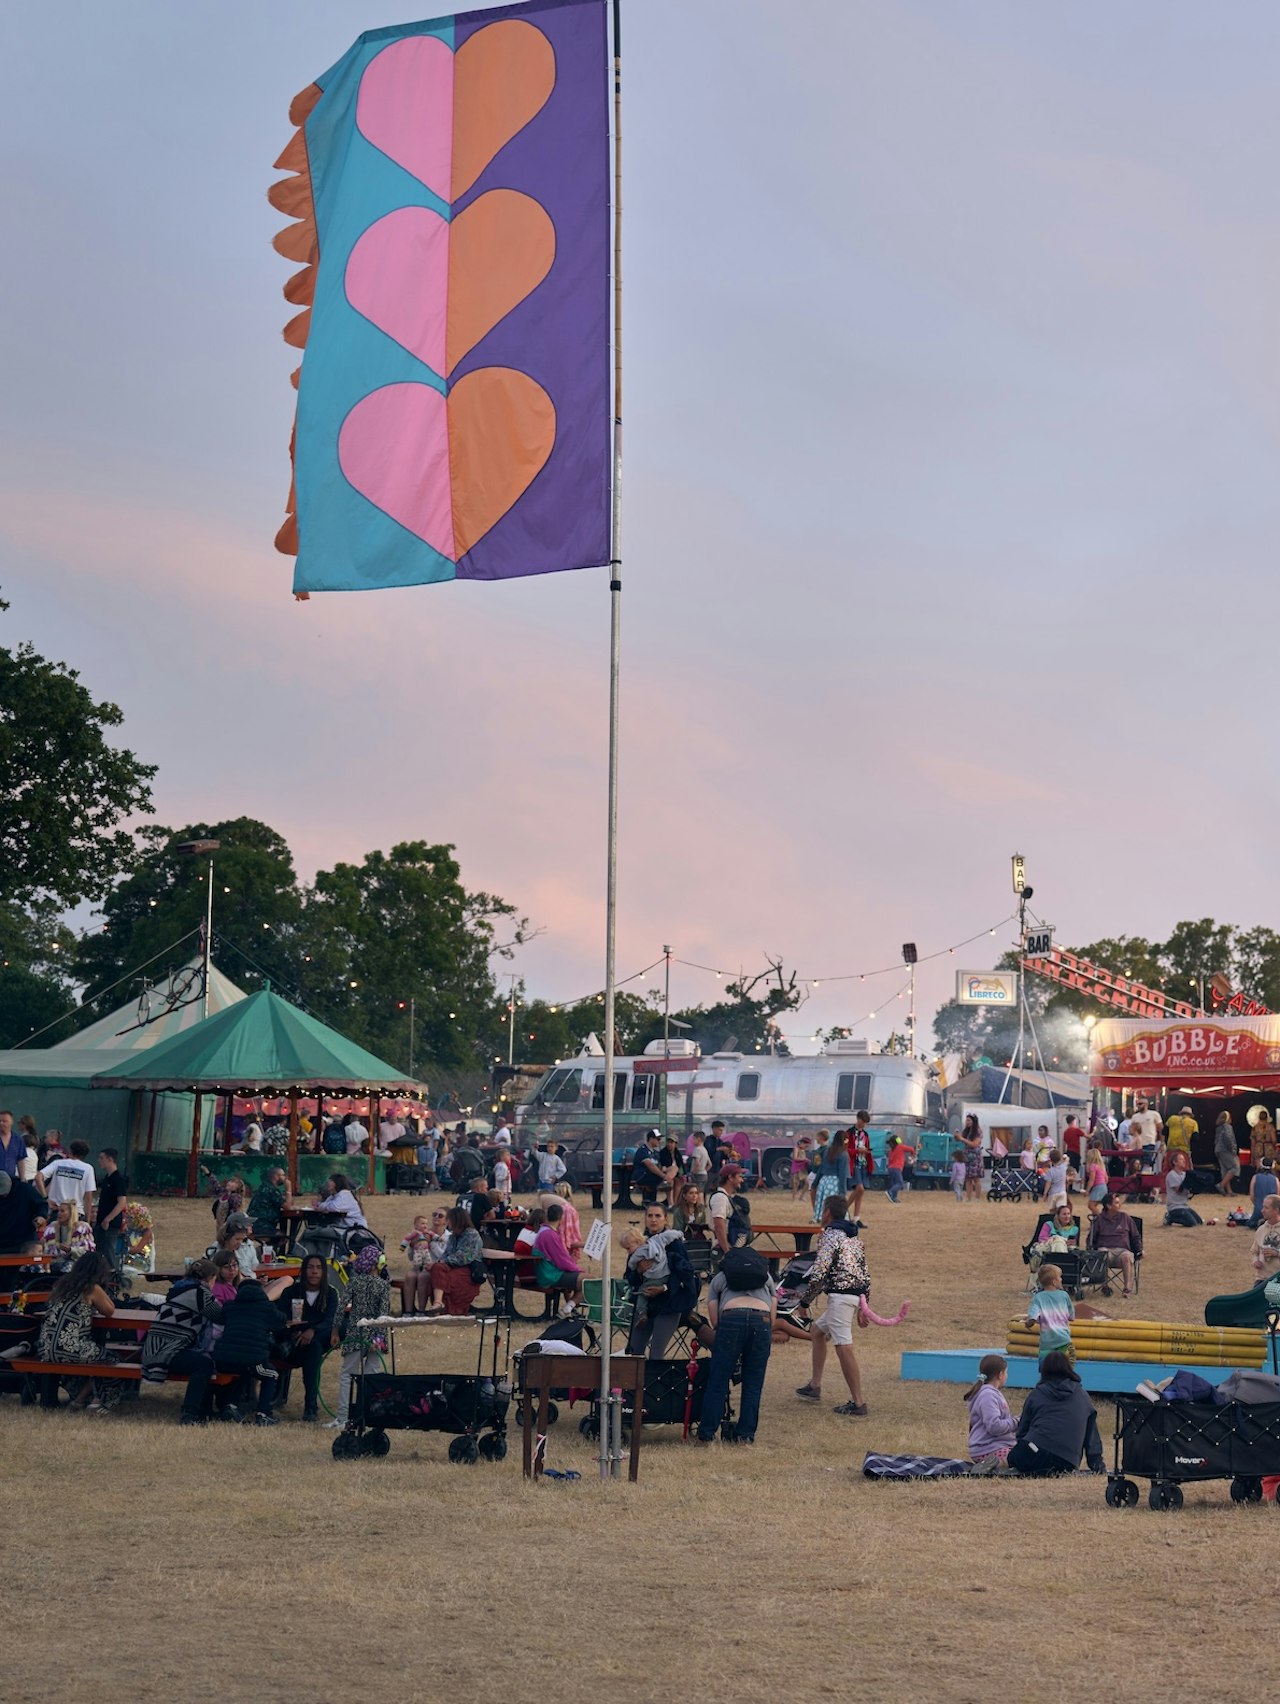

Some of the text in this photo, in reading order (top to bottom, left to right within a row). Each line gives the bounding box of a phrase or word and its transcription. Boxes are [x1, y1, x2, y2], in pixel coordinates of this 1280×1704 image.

[1016, 857, 1025, 890] BAR
[1027, 934, 1050, 955] BAR
[968, 979, 1005, 999] LIBRECO
[1133, 1028, 1240, 1064] BUBBLE
